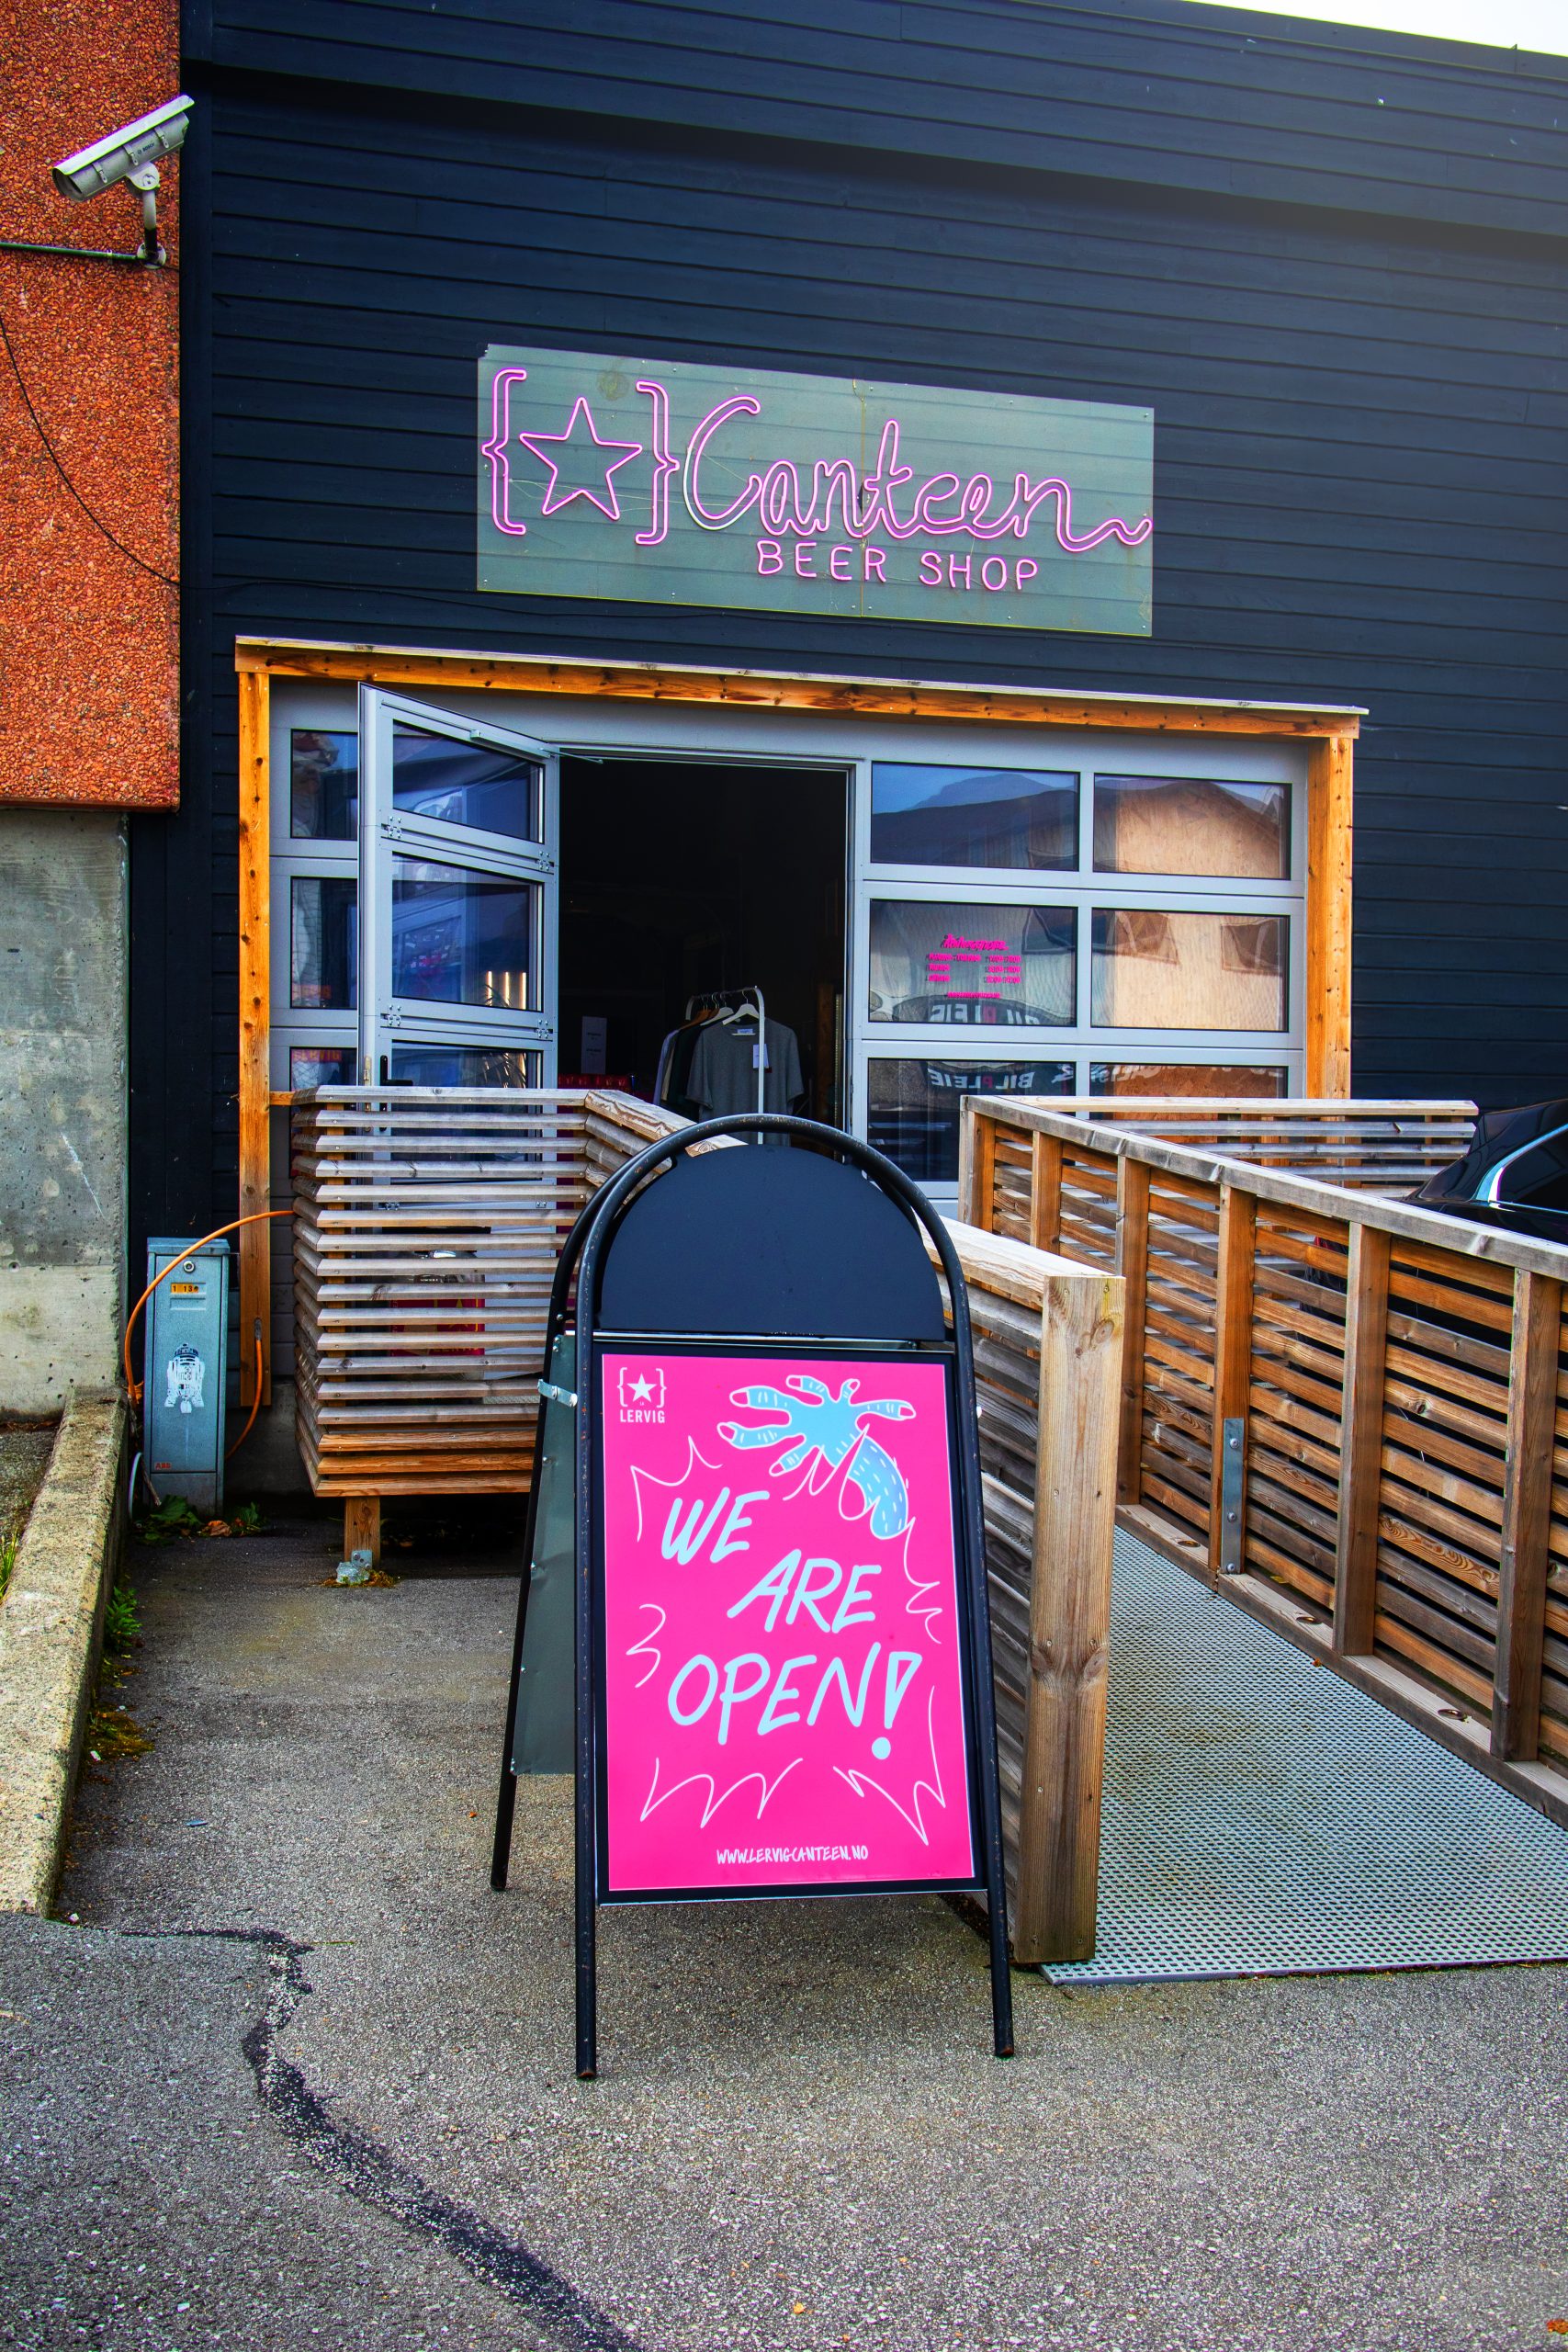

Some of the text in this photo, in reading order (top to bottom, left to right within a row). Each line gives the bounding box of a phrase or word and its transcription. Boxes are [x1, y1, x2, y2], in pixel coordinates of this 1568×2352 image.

[682, 395, 1153, 552] Canteen
[756, 539, 1039, 591] BEER SHOP
[619, 1408, 666, 1424] LERVIG
[660, 1487, 770, 1566] WE
[727, 1548, 882, 1634] ARE
[667, 1642, 922, 1760] OPEN!
[716, 1844, 869, 1865] WWW.LERVIGCANTEEN.NO
